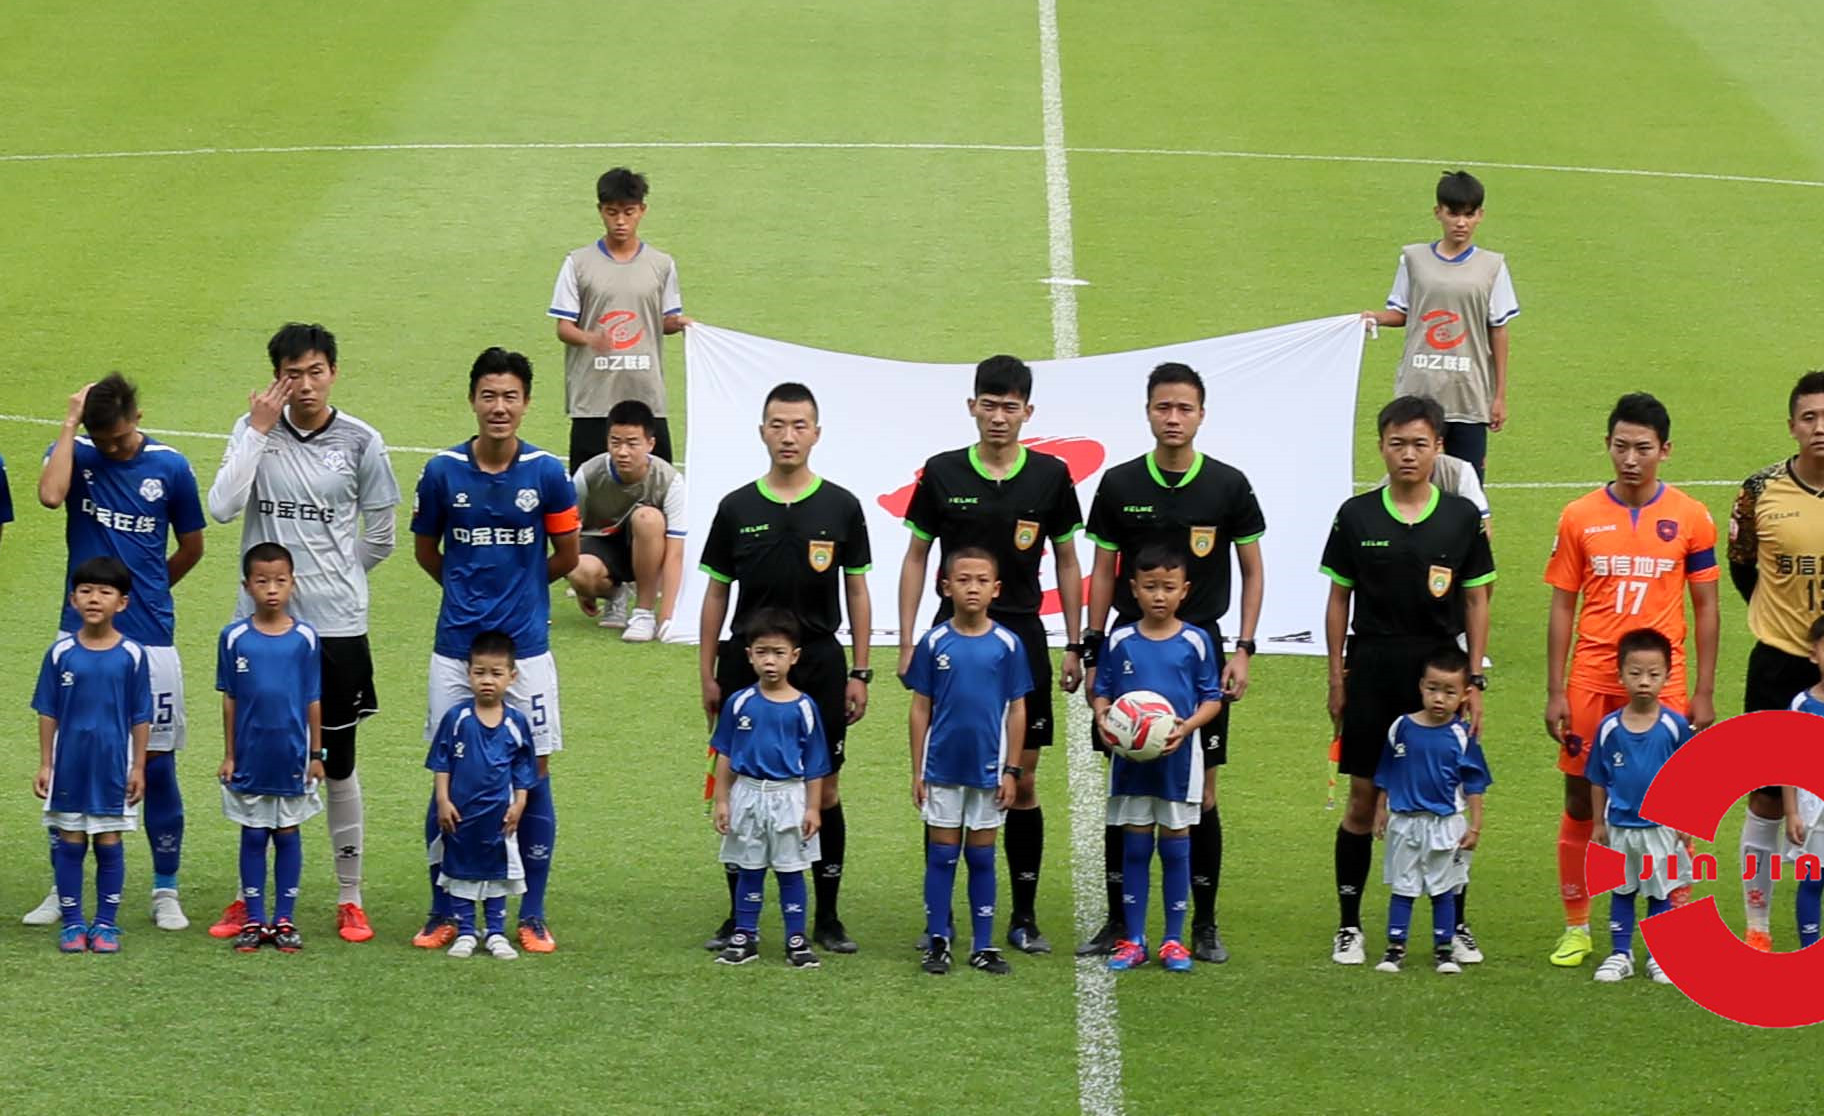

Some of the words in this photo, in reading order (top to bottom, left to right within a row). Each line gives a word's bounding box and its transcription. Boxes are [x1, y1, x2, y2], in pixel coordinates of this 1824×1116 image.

[594, 356, 651, 372] 中乙联赛
[1413, 354, 1472, 372] 中乙联赛
[259, 499, 335, 524] 中金在线
[452, 526, 536, 546] 中金在线
[1590, 555, 1676, 579] 海信地产
[1615, 580, 1649, 616] 17
[531, 694, 547, 727] 5
